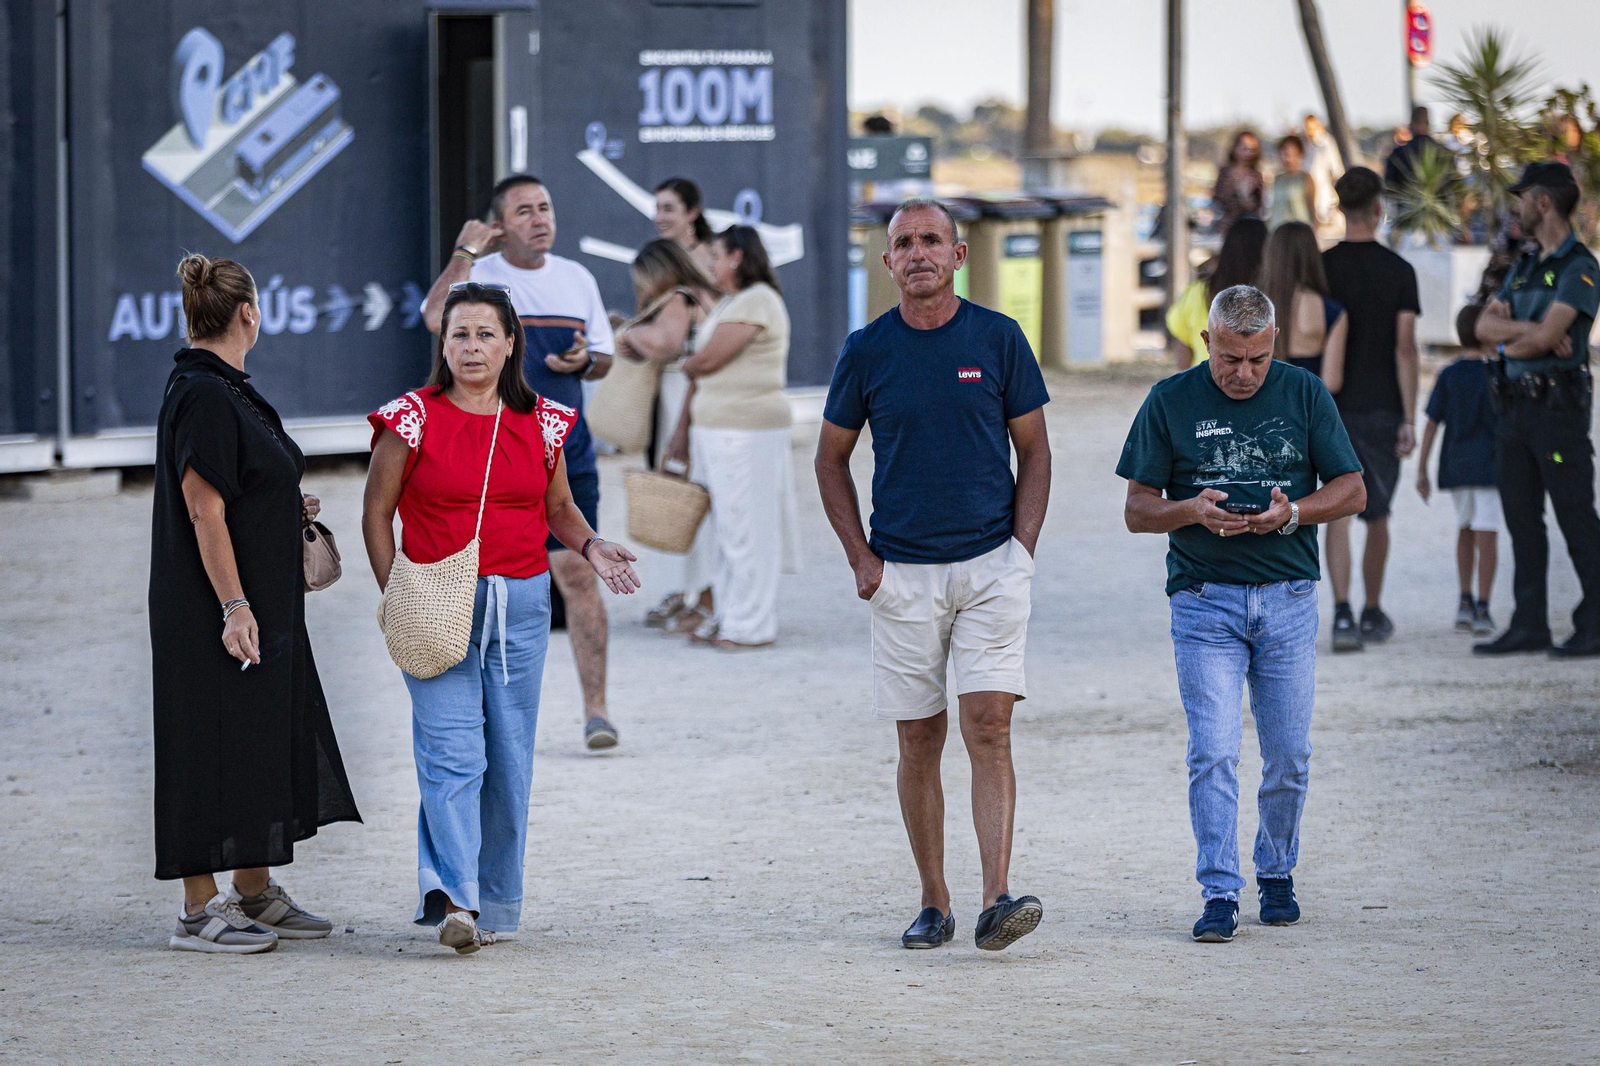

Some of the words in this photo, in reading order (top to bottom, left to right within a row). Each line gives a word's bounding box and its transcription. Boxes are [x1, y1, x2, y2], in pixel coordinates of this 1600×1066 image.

[638, 66, 774, 126] 100M
[108, 274, 318, 342] AUTÚS
[1195, 421, 1217, 431] STAY
